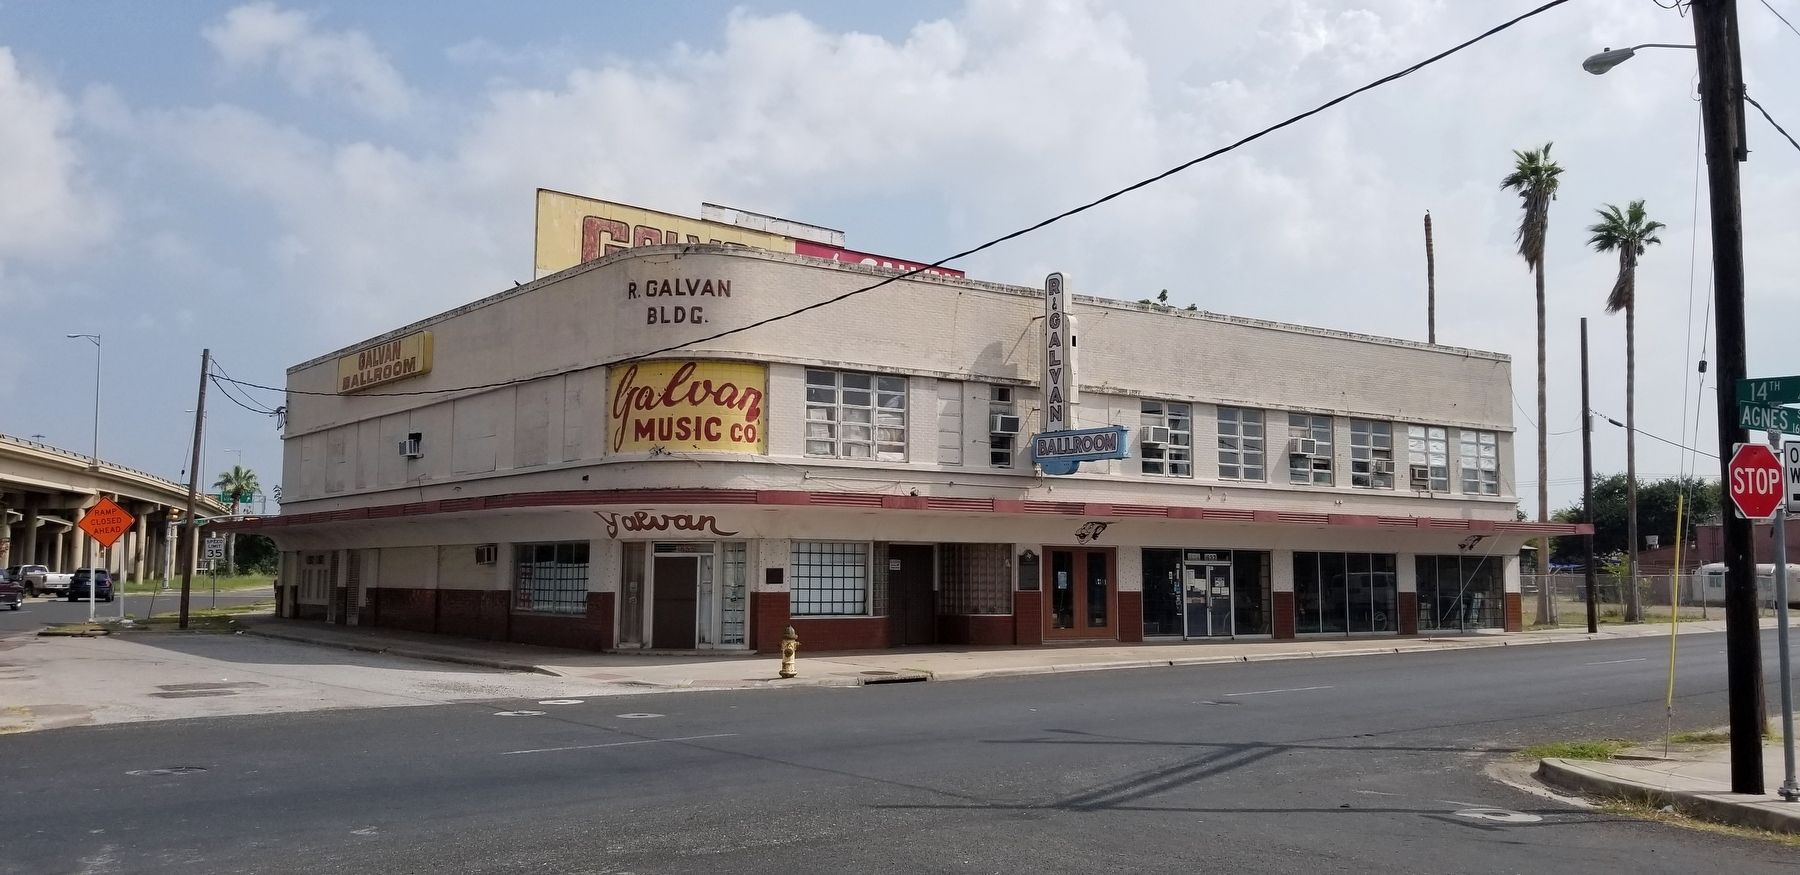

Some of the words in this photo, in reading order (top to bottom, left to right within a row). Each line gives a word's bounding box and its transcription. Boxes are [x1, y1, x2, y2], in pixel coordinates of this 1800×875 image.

[628, 279, 641, 300] R.
[646, 278, 732, 298] GALVAN
[647, 306, 710, 325] BLDG.
[358, 340, 401, 371] GALVAN
[1049, 312, 1062, 422] GALVAN
[342, 356, 416, 391] BALLROOM
[613, 361, 763, 453] Galvan
[1741, 405, 1788, 430] AGNES
[634, 416, 722, 442] MUSIC
[1037, 432, 1117, 457] BALLROOM
[1733, 467, 1780, 495] STOP
[90, 517, 122, 526] CLOSED
[94, 508, 117, 516] RAMP
[93, 526, 121, 535] AHEAD
[207, 549, 223, 558] 35
